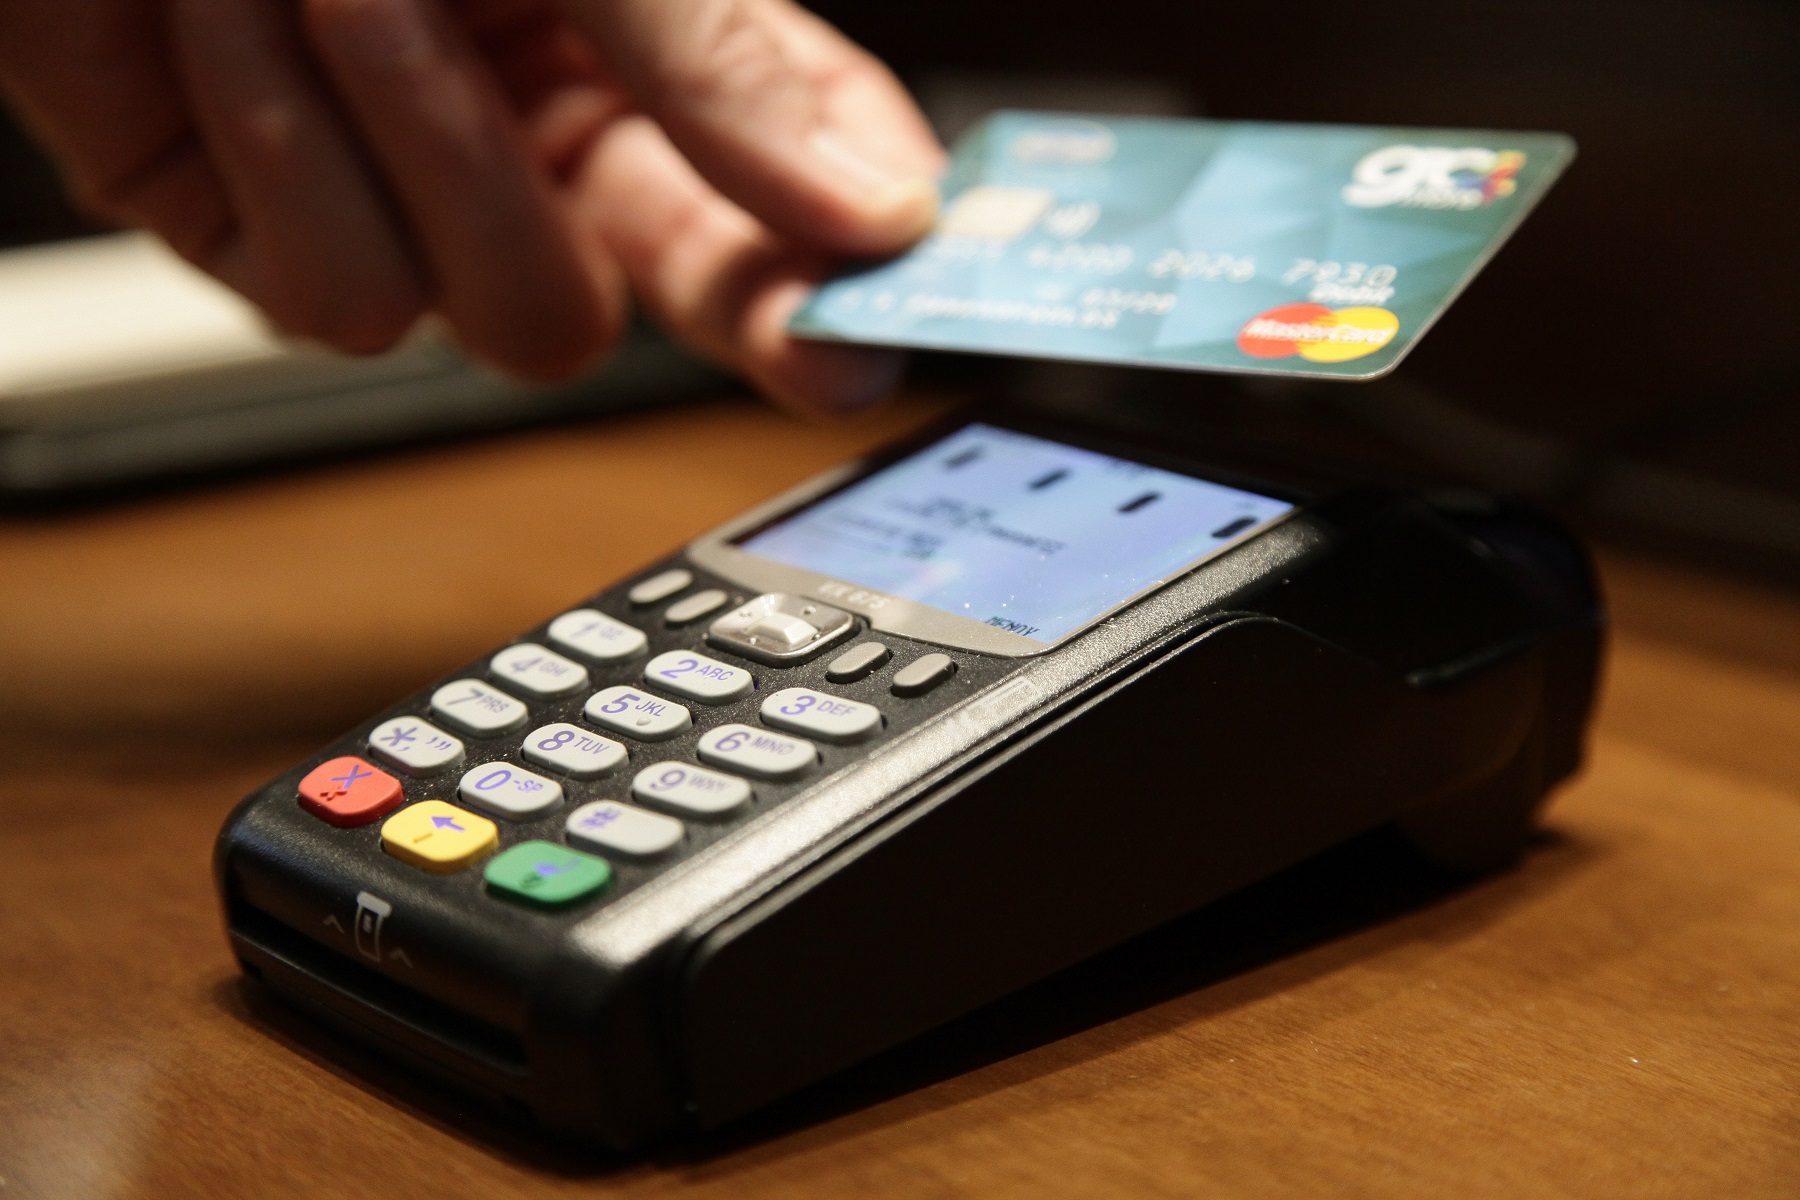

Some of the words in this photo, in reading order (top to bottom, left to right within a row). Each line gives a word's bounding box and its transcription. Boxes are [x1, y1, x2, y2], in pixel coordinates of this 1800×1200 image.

[1244, 318, 1396, 345] MasterCard
[569, 621, 600, 639] 1
[511, 657, 544, 672] 4
[660, 658, 699, 680] 2
[696, 664, 734, 681] ABC
[446, 687, 485, 706] 7
[475, 694, 510, 714] PRS
[600, 693, 641, 714] 5
[634, 700, 667, 717] JKL
[780, 695, 817, 715] 3
[816, 700, 857, 717] DEF
[537, 730, 575, 751] 8
[573, 736, 610, 755] TUV
[715, 731, 750, 752] 6
[751, 735, 797, 756] MNO
[474, 769, 513, 791] 0
[649, 769, 687, 792] 9
